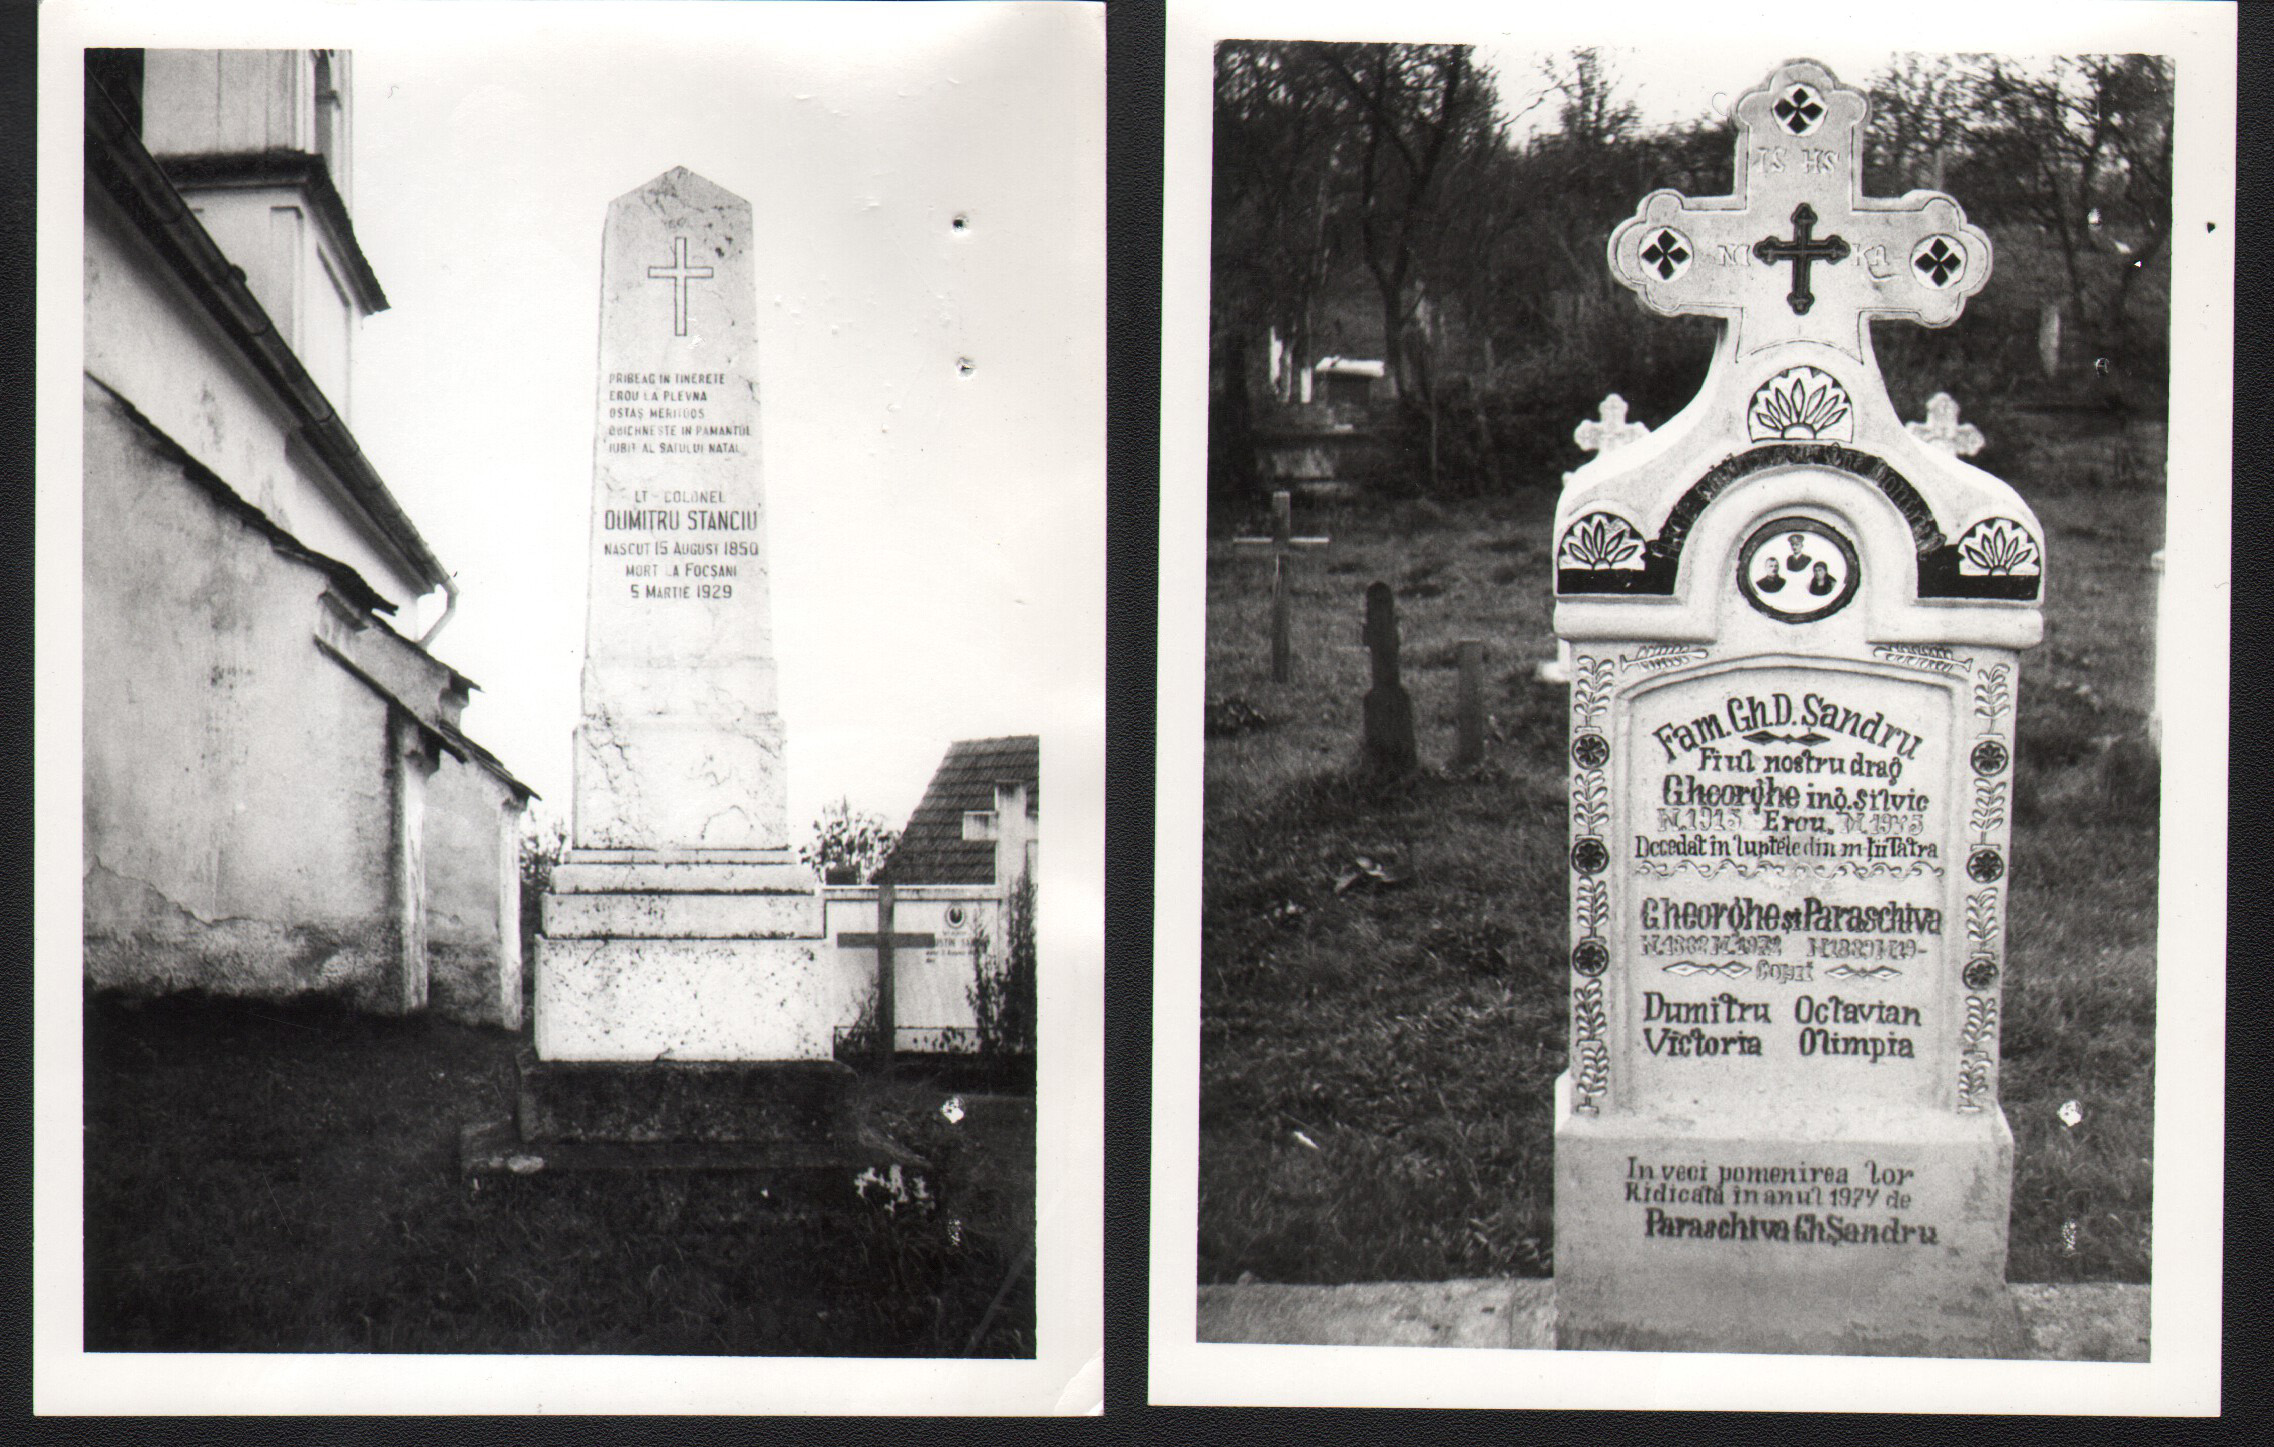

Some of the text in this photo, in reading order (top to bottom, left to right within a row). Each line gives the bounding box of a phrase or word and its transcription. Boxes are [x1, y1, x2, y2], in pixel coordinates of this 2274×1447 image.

[609, 373, 726, 385] PRIBEAG IN TINERETE
[609, 390, 708, 402] EROU LA PLEVNA
[681, 425, 692, 436] IN
[642, 442, 656, 454] AL
[664, 490, 726, 503] COLONEL
[604, 510, 758, 531] DUMITRU STANCIU
[604, 542, 651, 556] NASCUT
[655, 541, 669, 555] 15
[723, 541, 760, 556] 1850
[625, 564, 659, 577] MORT
[666, 564, 680, 577] LA
[630, 584, 733, 600] 5 MARTIE 1929
[1698, 747, 1902, 786] Fiul nostru drag
[1662, 774, 1801, 815] Gheorghe
[1803, 835, 1838, 858] din
[1640, 897, 1781, 936] Gheorghe
[1803, 897, 1944, 935] Paraschiva
[1643, 992, 1922, 1027] Dumitru Octavian
[1643, 1026, 1915, 1064] Victoria Olimpia
[1660, 1160, 1708, 1182] veci
[1718, 1160, 1848, 1186] pomenirea
[1864, 1159, 1915, 1186] lor
[1763, 1186, 1822, 1207] anul
[1885, 1189, 1912, 1210] de
[1644, 1207, 1790, 1242] Paraschiva
